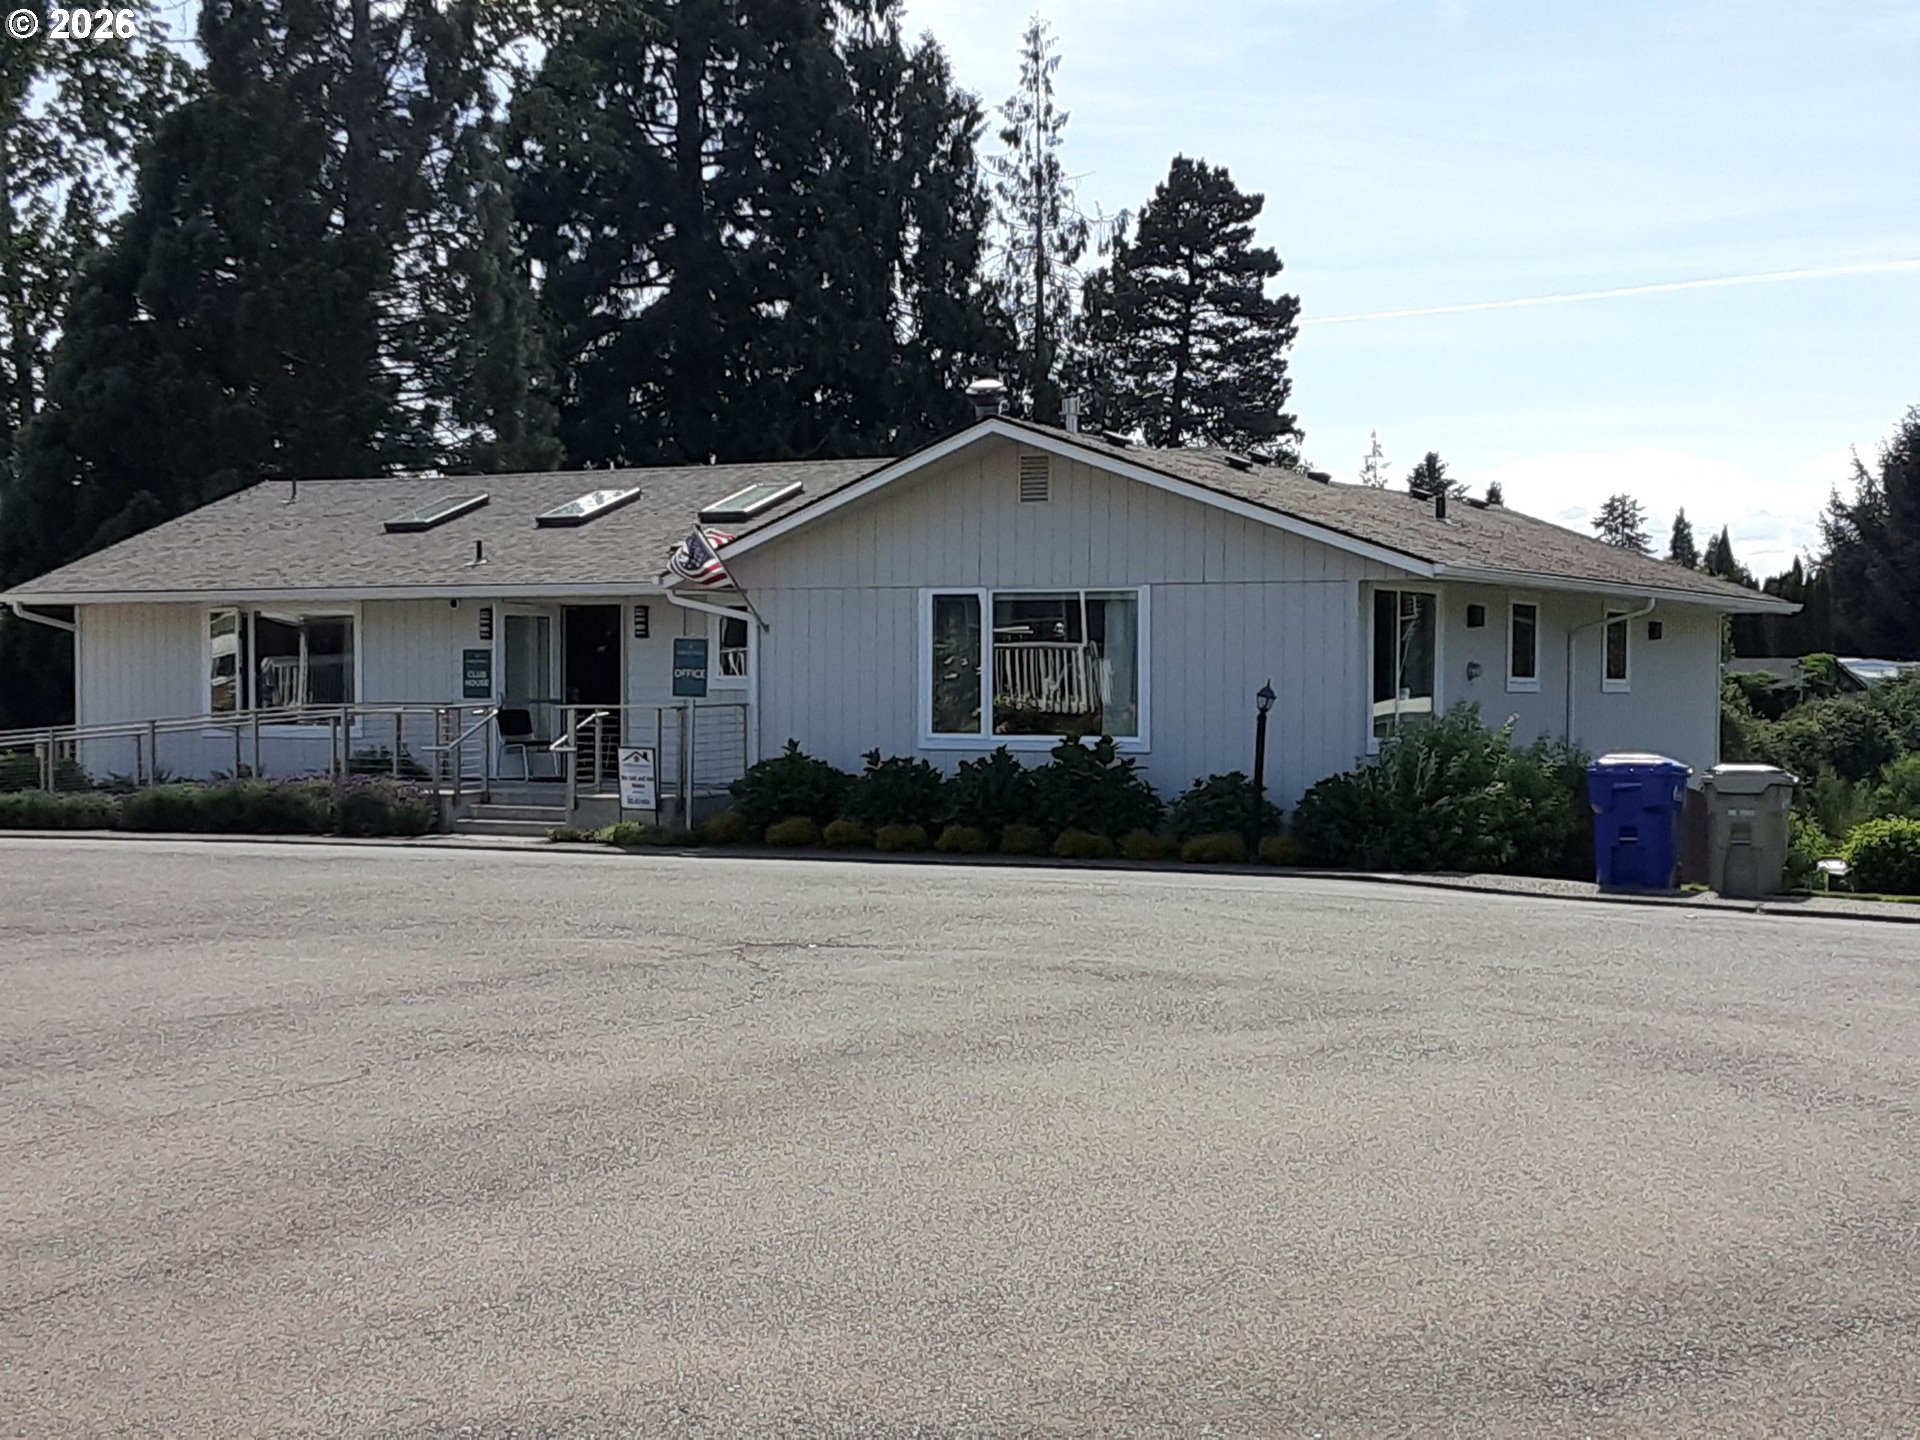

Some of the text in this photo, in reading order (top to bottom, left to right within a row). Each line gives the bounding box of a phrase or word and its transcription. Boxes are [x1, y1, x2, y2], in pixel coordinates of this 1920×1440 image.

[467, 670, 488, 679] CLUB
[674, 668, 706, 679] OFFICE
[465, 679, 490, 688] HOUSE
